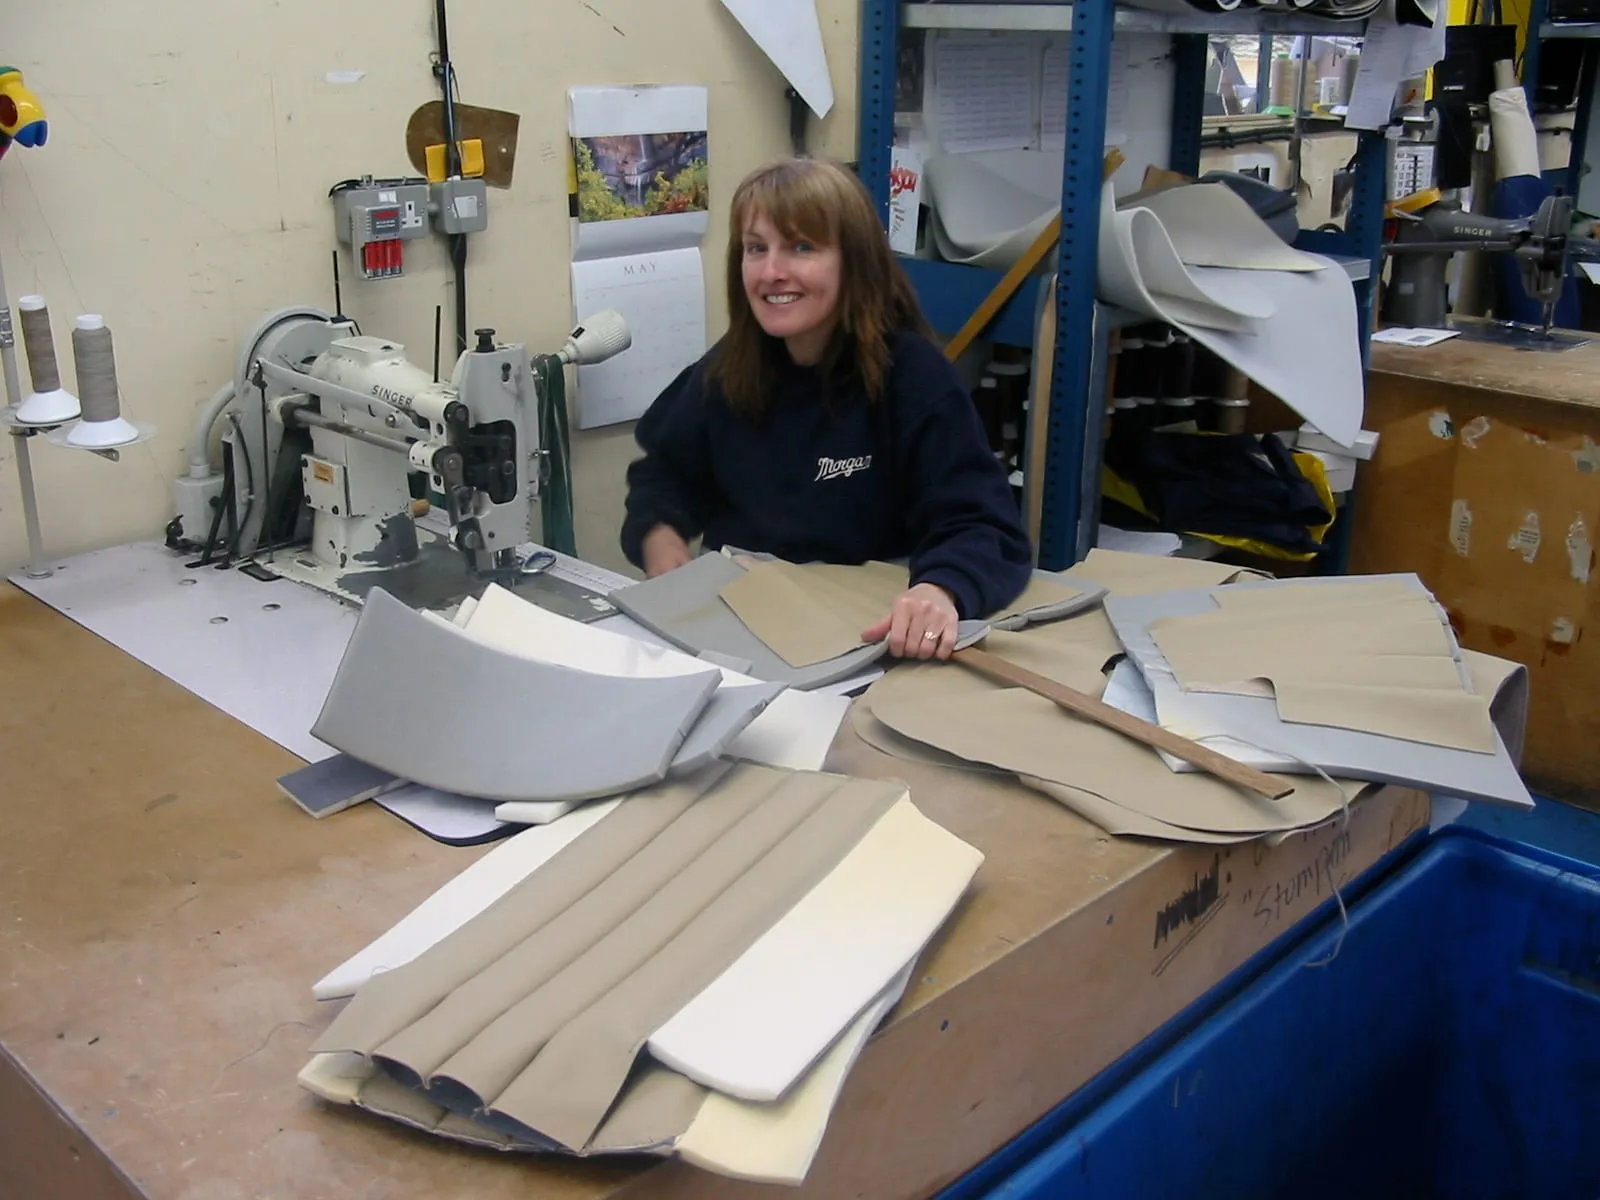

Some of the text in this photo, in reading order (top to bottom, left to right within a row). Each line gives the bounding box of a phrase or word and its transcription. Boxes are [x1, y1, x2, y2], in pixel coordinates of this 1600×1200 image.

[1454, 226, 1492, 237] SINGER
[624, 262, 657, 276] MAY
[371, 384, 413, 407] SINGER
